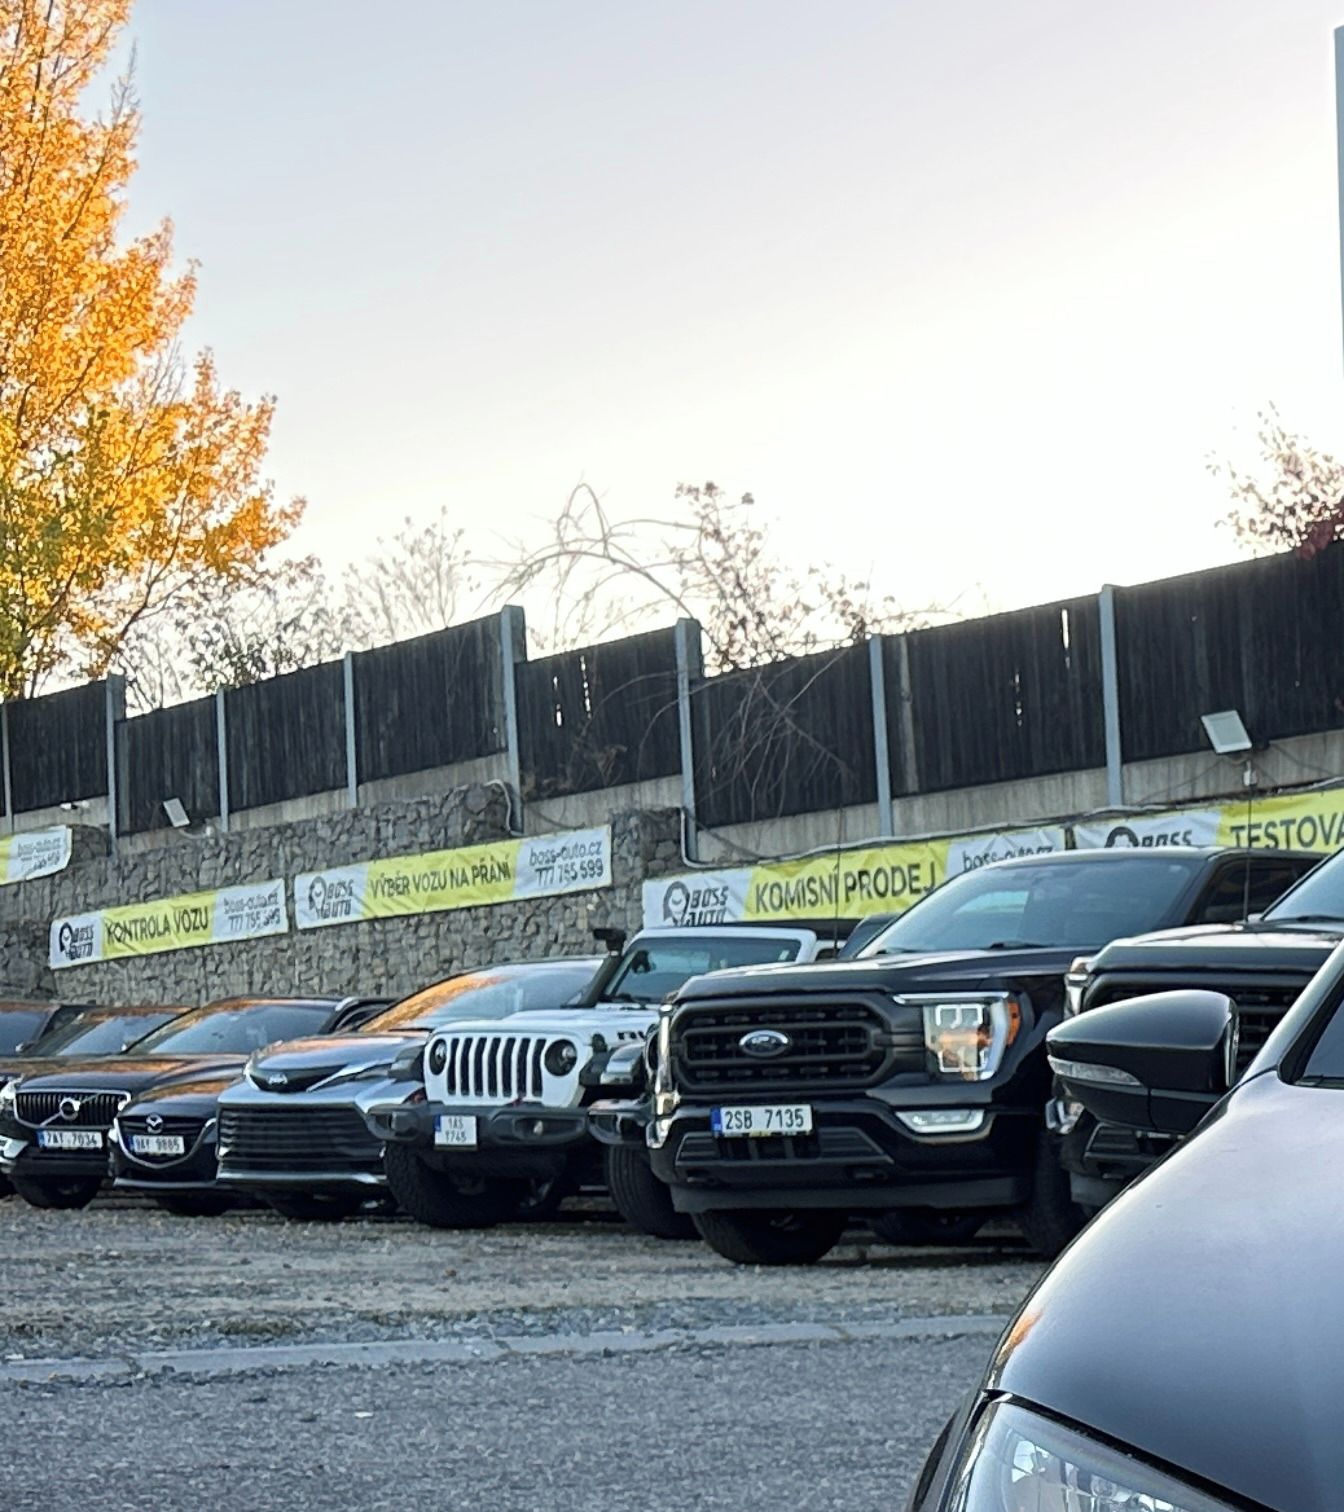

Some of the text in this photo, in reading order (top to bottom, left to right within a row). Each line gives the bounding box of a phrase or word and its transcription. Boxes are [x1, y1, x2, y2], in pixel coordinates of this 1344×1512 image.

[530, 840, 602, 867] boss-auto.cz
[413, 870, 448, 892] VOZU
[450, 866, 469, 888] NA
[755, 861, 937, 914] KOMISNÍ PRODEJ
[690, 885, 729, 909] BOSS
[105, 907, 209, 946] KONTROLA VOZU
[724, 1107, 804, 1131] 2SB 7135
